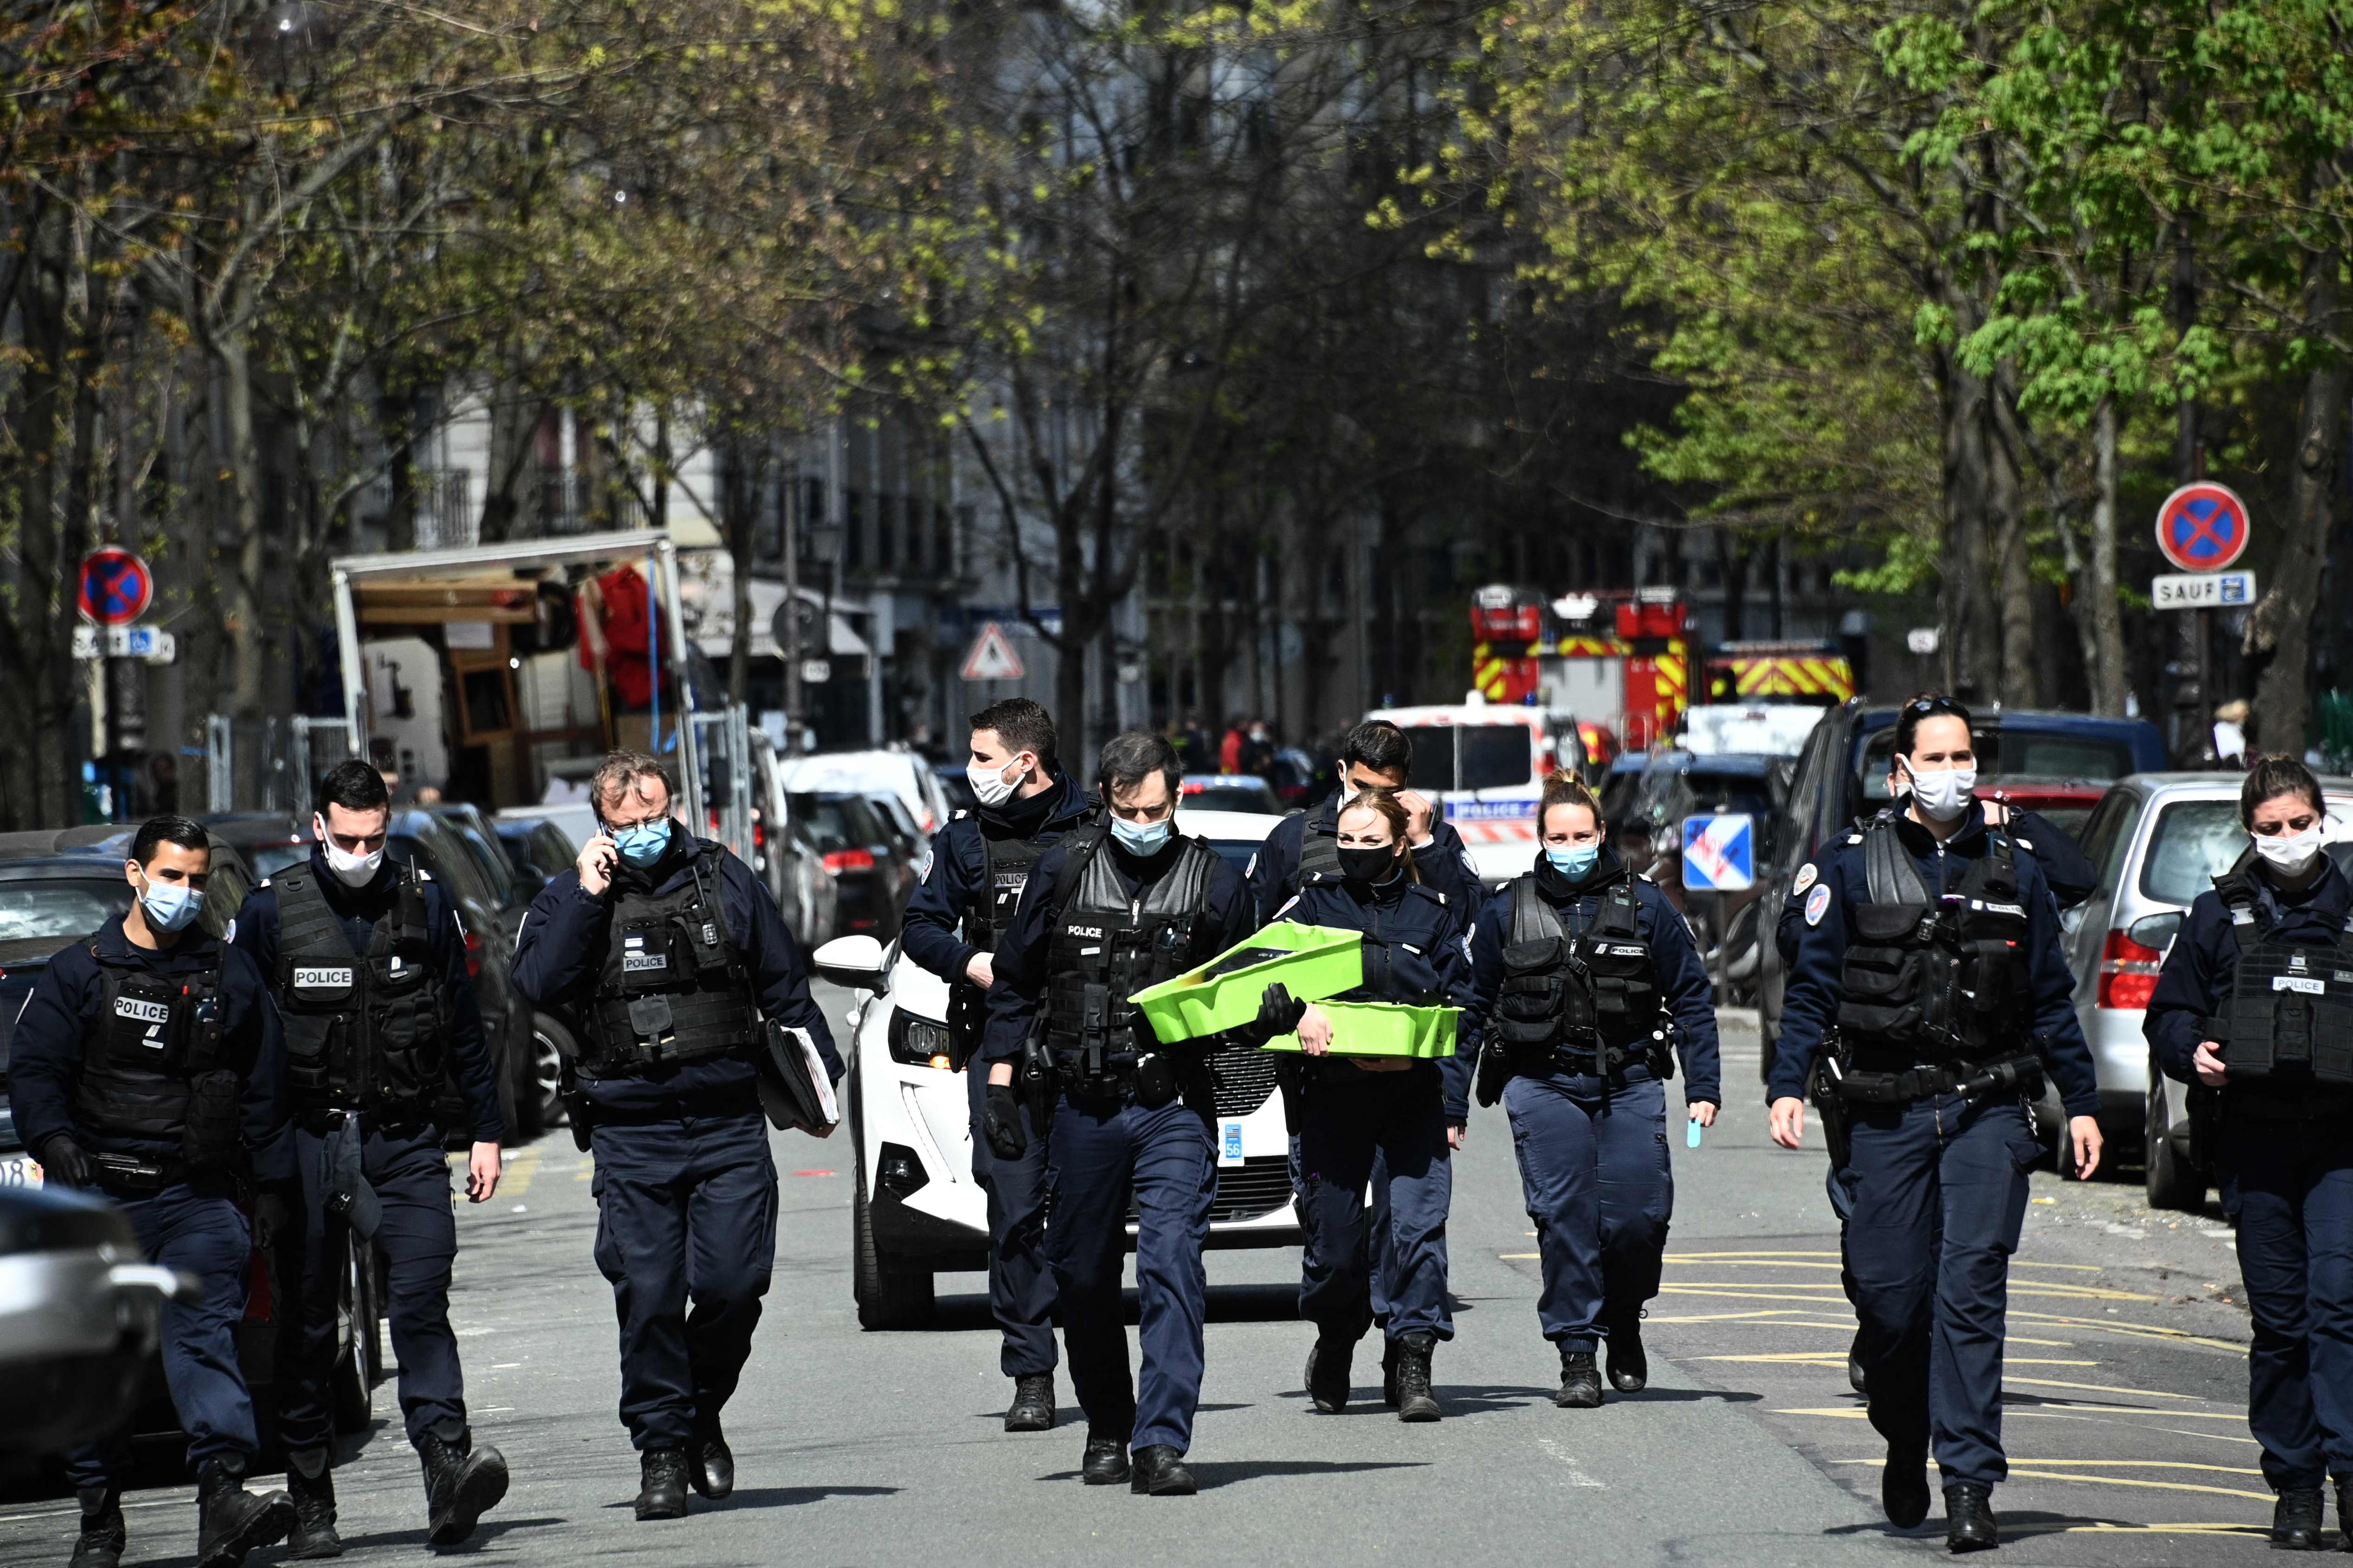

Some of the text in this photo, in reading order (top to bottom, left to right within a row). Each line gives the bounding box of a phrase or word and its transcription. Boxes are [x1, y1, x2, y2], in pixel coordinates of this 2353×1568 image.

[2161, 582, 2213, 602] SAUF
[1458, 803, 1520, 818] POLICE
[1068, 926, 1102, 938] POLICE
[627, 957, 663, 968] POLICE
[296, 972, 350, 983] POLICE
[2278, 980, 2319, 990] POLICE
[116, 999, 168, 1020] POLICE
[1226, 1144, 1240, 1156] 56
